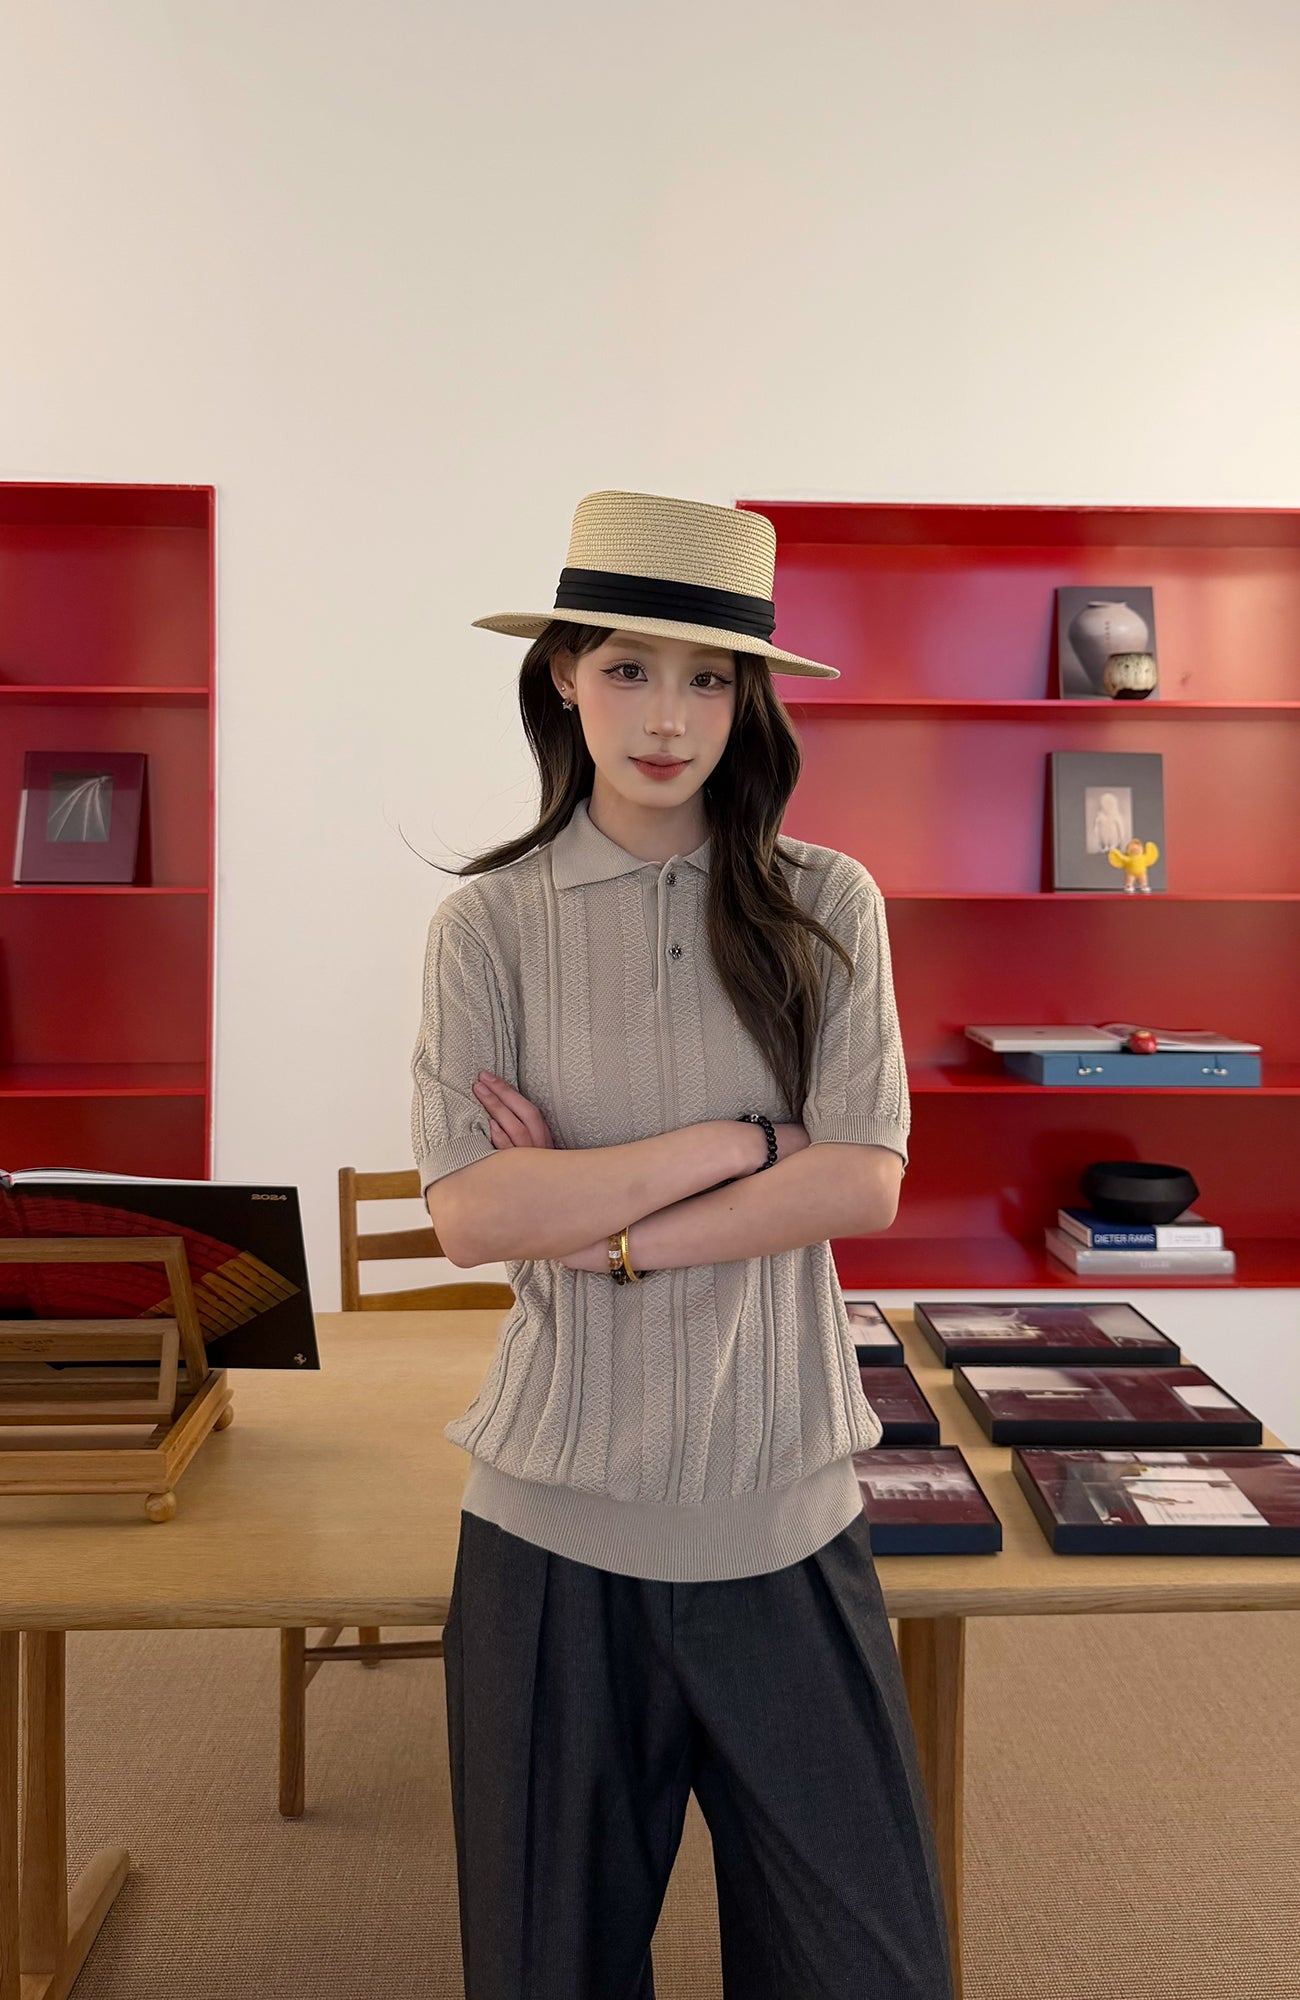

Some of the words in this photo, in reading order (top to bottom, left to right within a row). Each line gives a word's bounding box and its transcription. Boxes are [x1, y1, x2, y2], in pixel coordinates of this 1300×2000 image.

[251, 1193, 288, 1201] 2024
[1094, 1233, 1128, 1245] DIETER
[1128, 1233, 1156, 1244] RAMS
